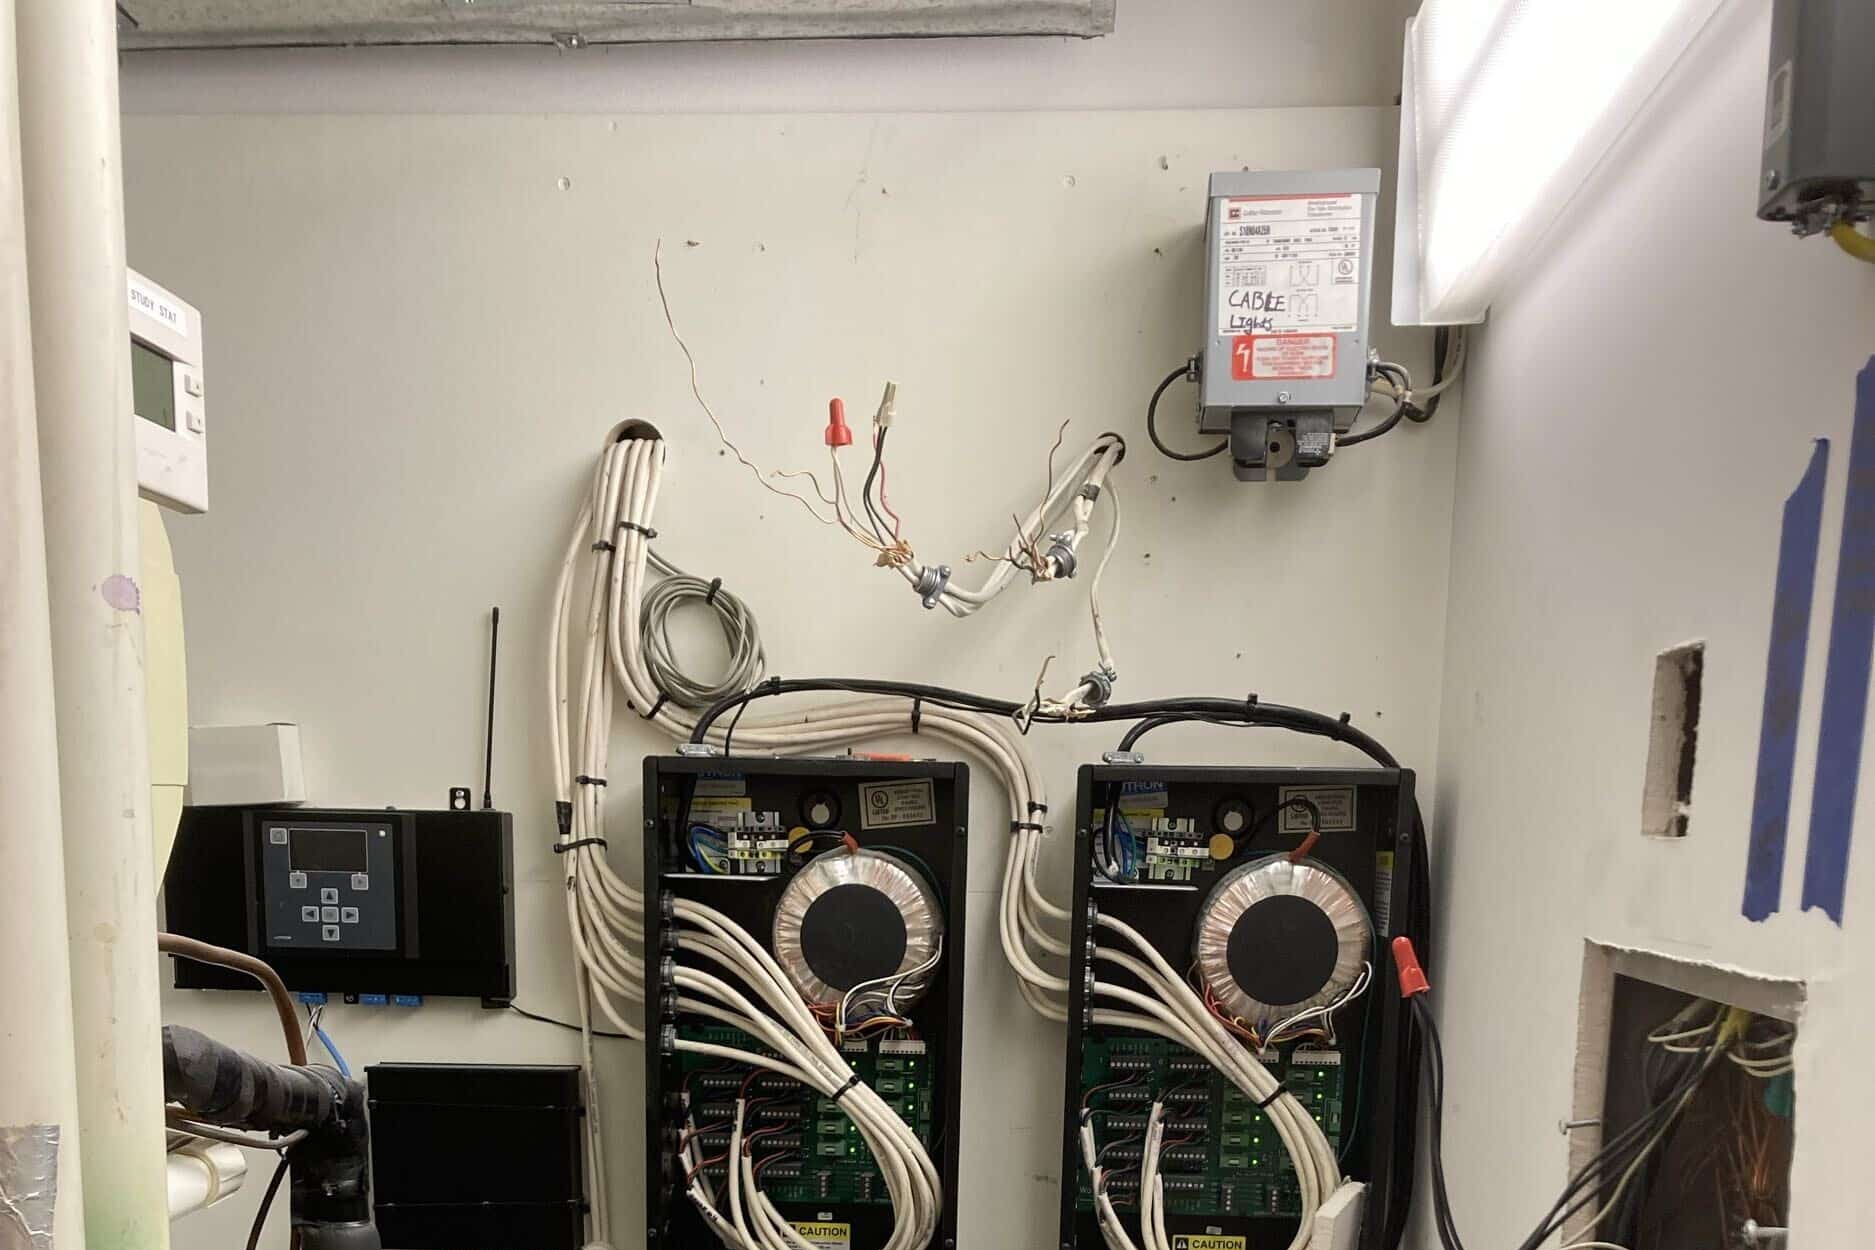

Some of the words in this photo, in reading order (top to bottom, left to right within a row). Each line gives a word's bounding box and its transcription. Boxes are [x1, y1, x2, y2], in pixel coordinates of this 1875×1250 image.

[131, 289, 155, 311] STUDY
[160, 305, 177, 323] STAT
[1228, 289, 1286, 312] CABLE
[799, 1226, 847, 1237] CAUTION
[1192, 1239, 1242, 1250] CAUTION
